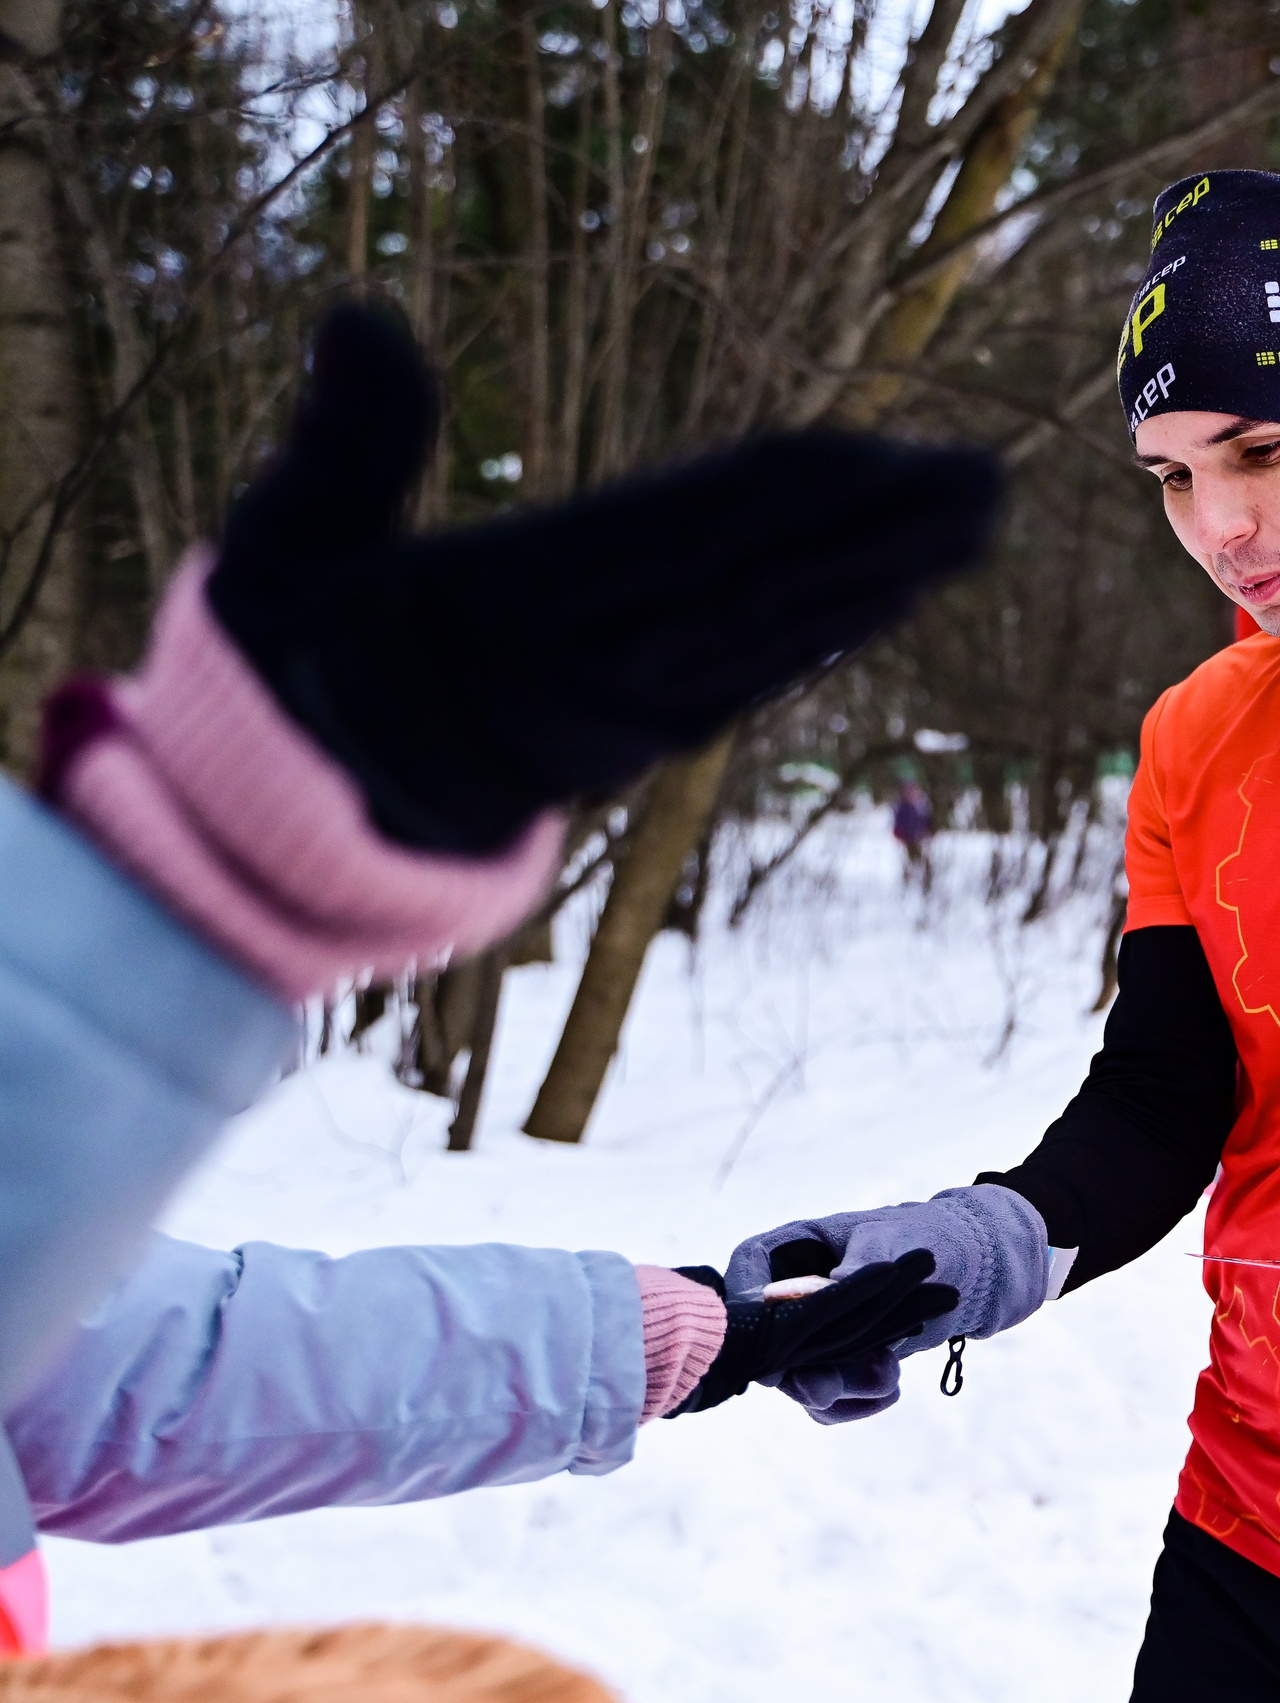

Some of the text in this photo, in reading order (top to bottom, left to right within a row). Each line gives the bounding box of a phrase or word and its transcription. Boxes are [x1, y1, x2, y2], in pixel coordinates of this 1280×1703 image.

[1164, 178, 1209, 228] cep
[1152, 256, 1186, 284] cep
[1134, 362, 1176, 420] cep
